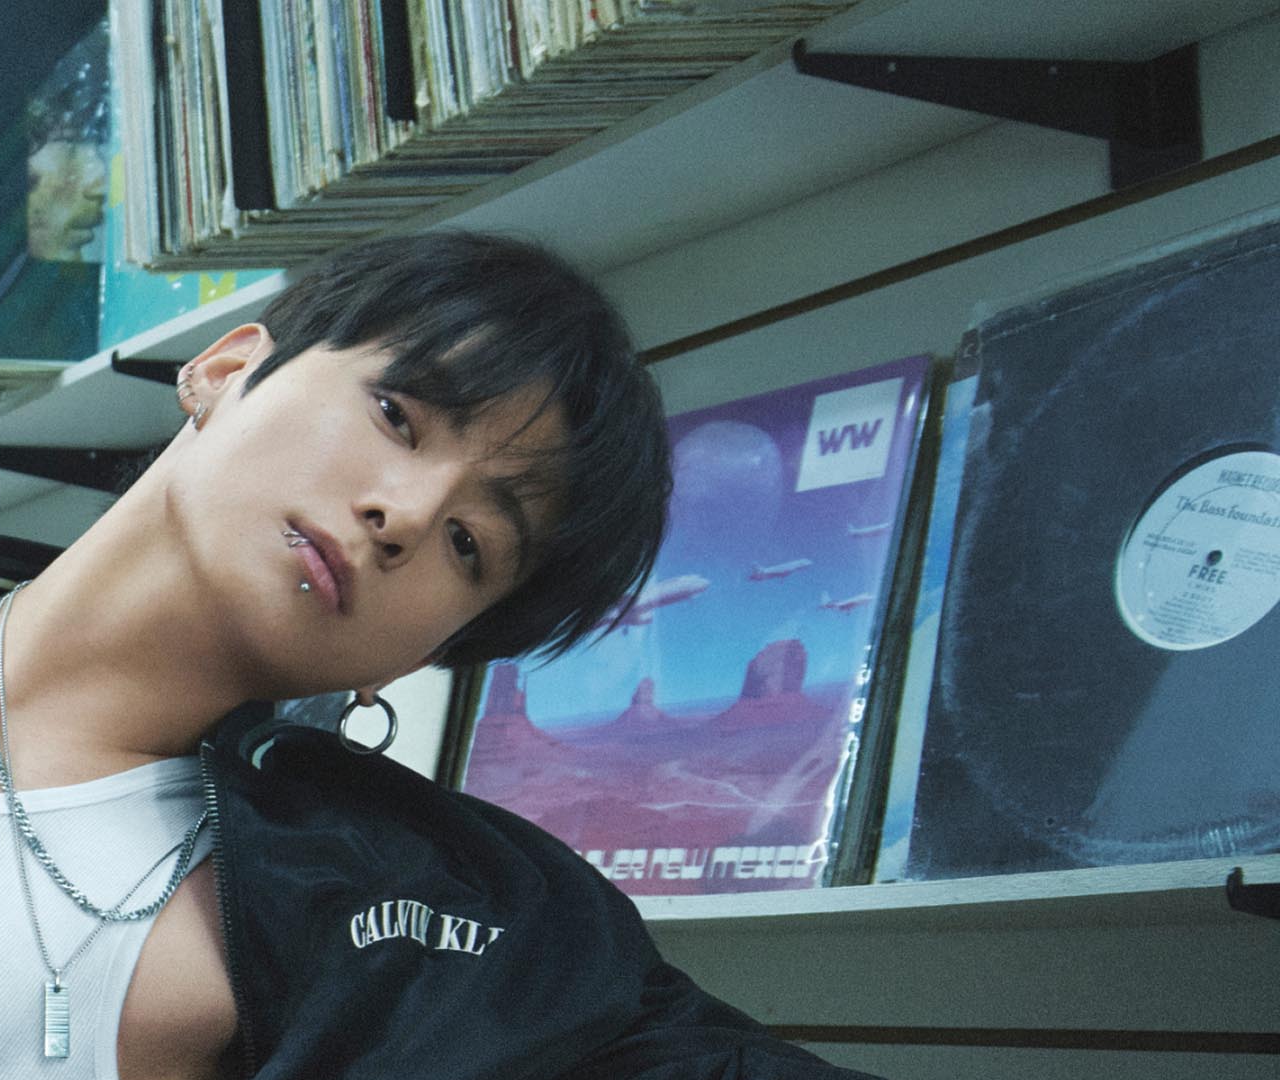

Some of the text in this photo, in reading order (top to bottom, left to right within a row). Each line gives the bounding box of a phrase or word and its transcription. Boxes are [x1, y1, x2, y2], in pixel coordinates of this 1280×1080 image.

[818, 418, 883, 456] WW
[1176, 496, 1196, 512] The
[1200, 501, 1226, 517] Bass
[1187, 564, 1228, 584] FREE
